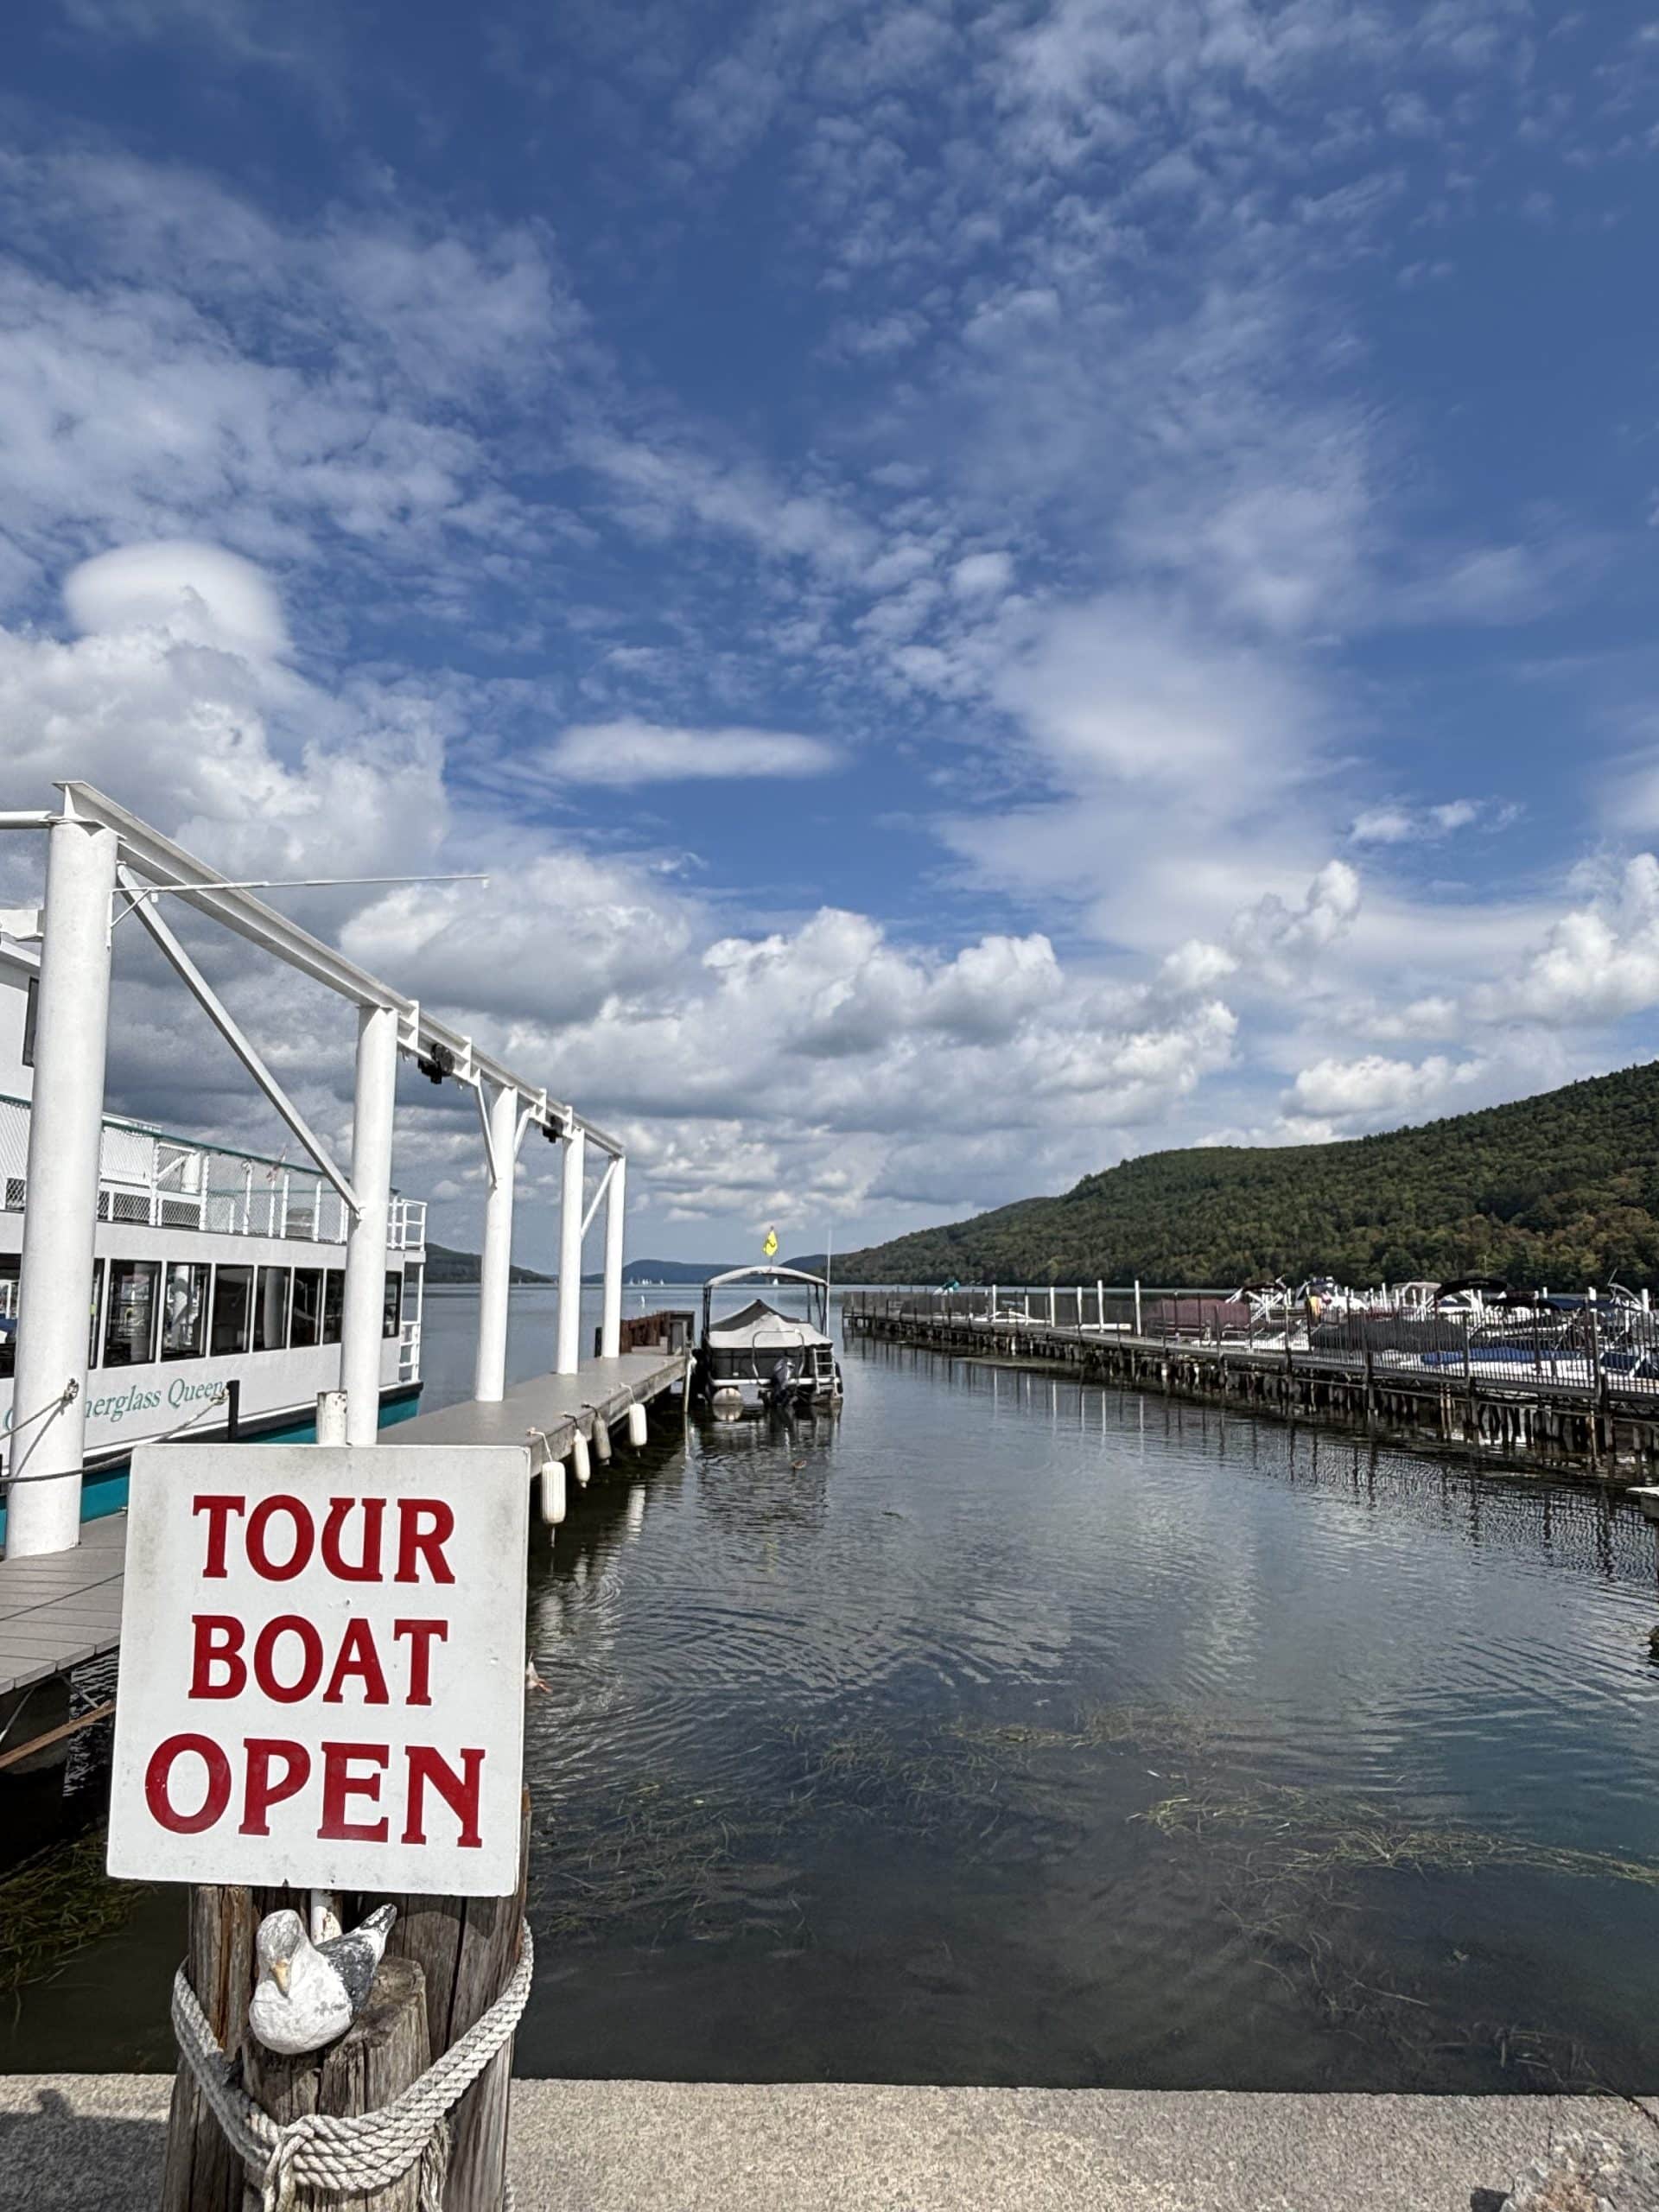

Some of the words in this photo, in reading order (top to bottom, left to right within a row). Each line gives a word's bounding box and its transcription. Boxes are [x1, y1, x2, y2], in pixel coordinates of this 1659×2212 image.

[168, 1378, 224, 1408] Queen
[193, 1494, 455, 1584] TOUR
[188, 1614, 448, 1706] BOAT
[144, 1732, 486, 1848] OPEN
